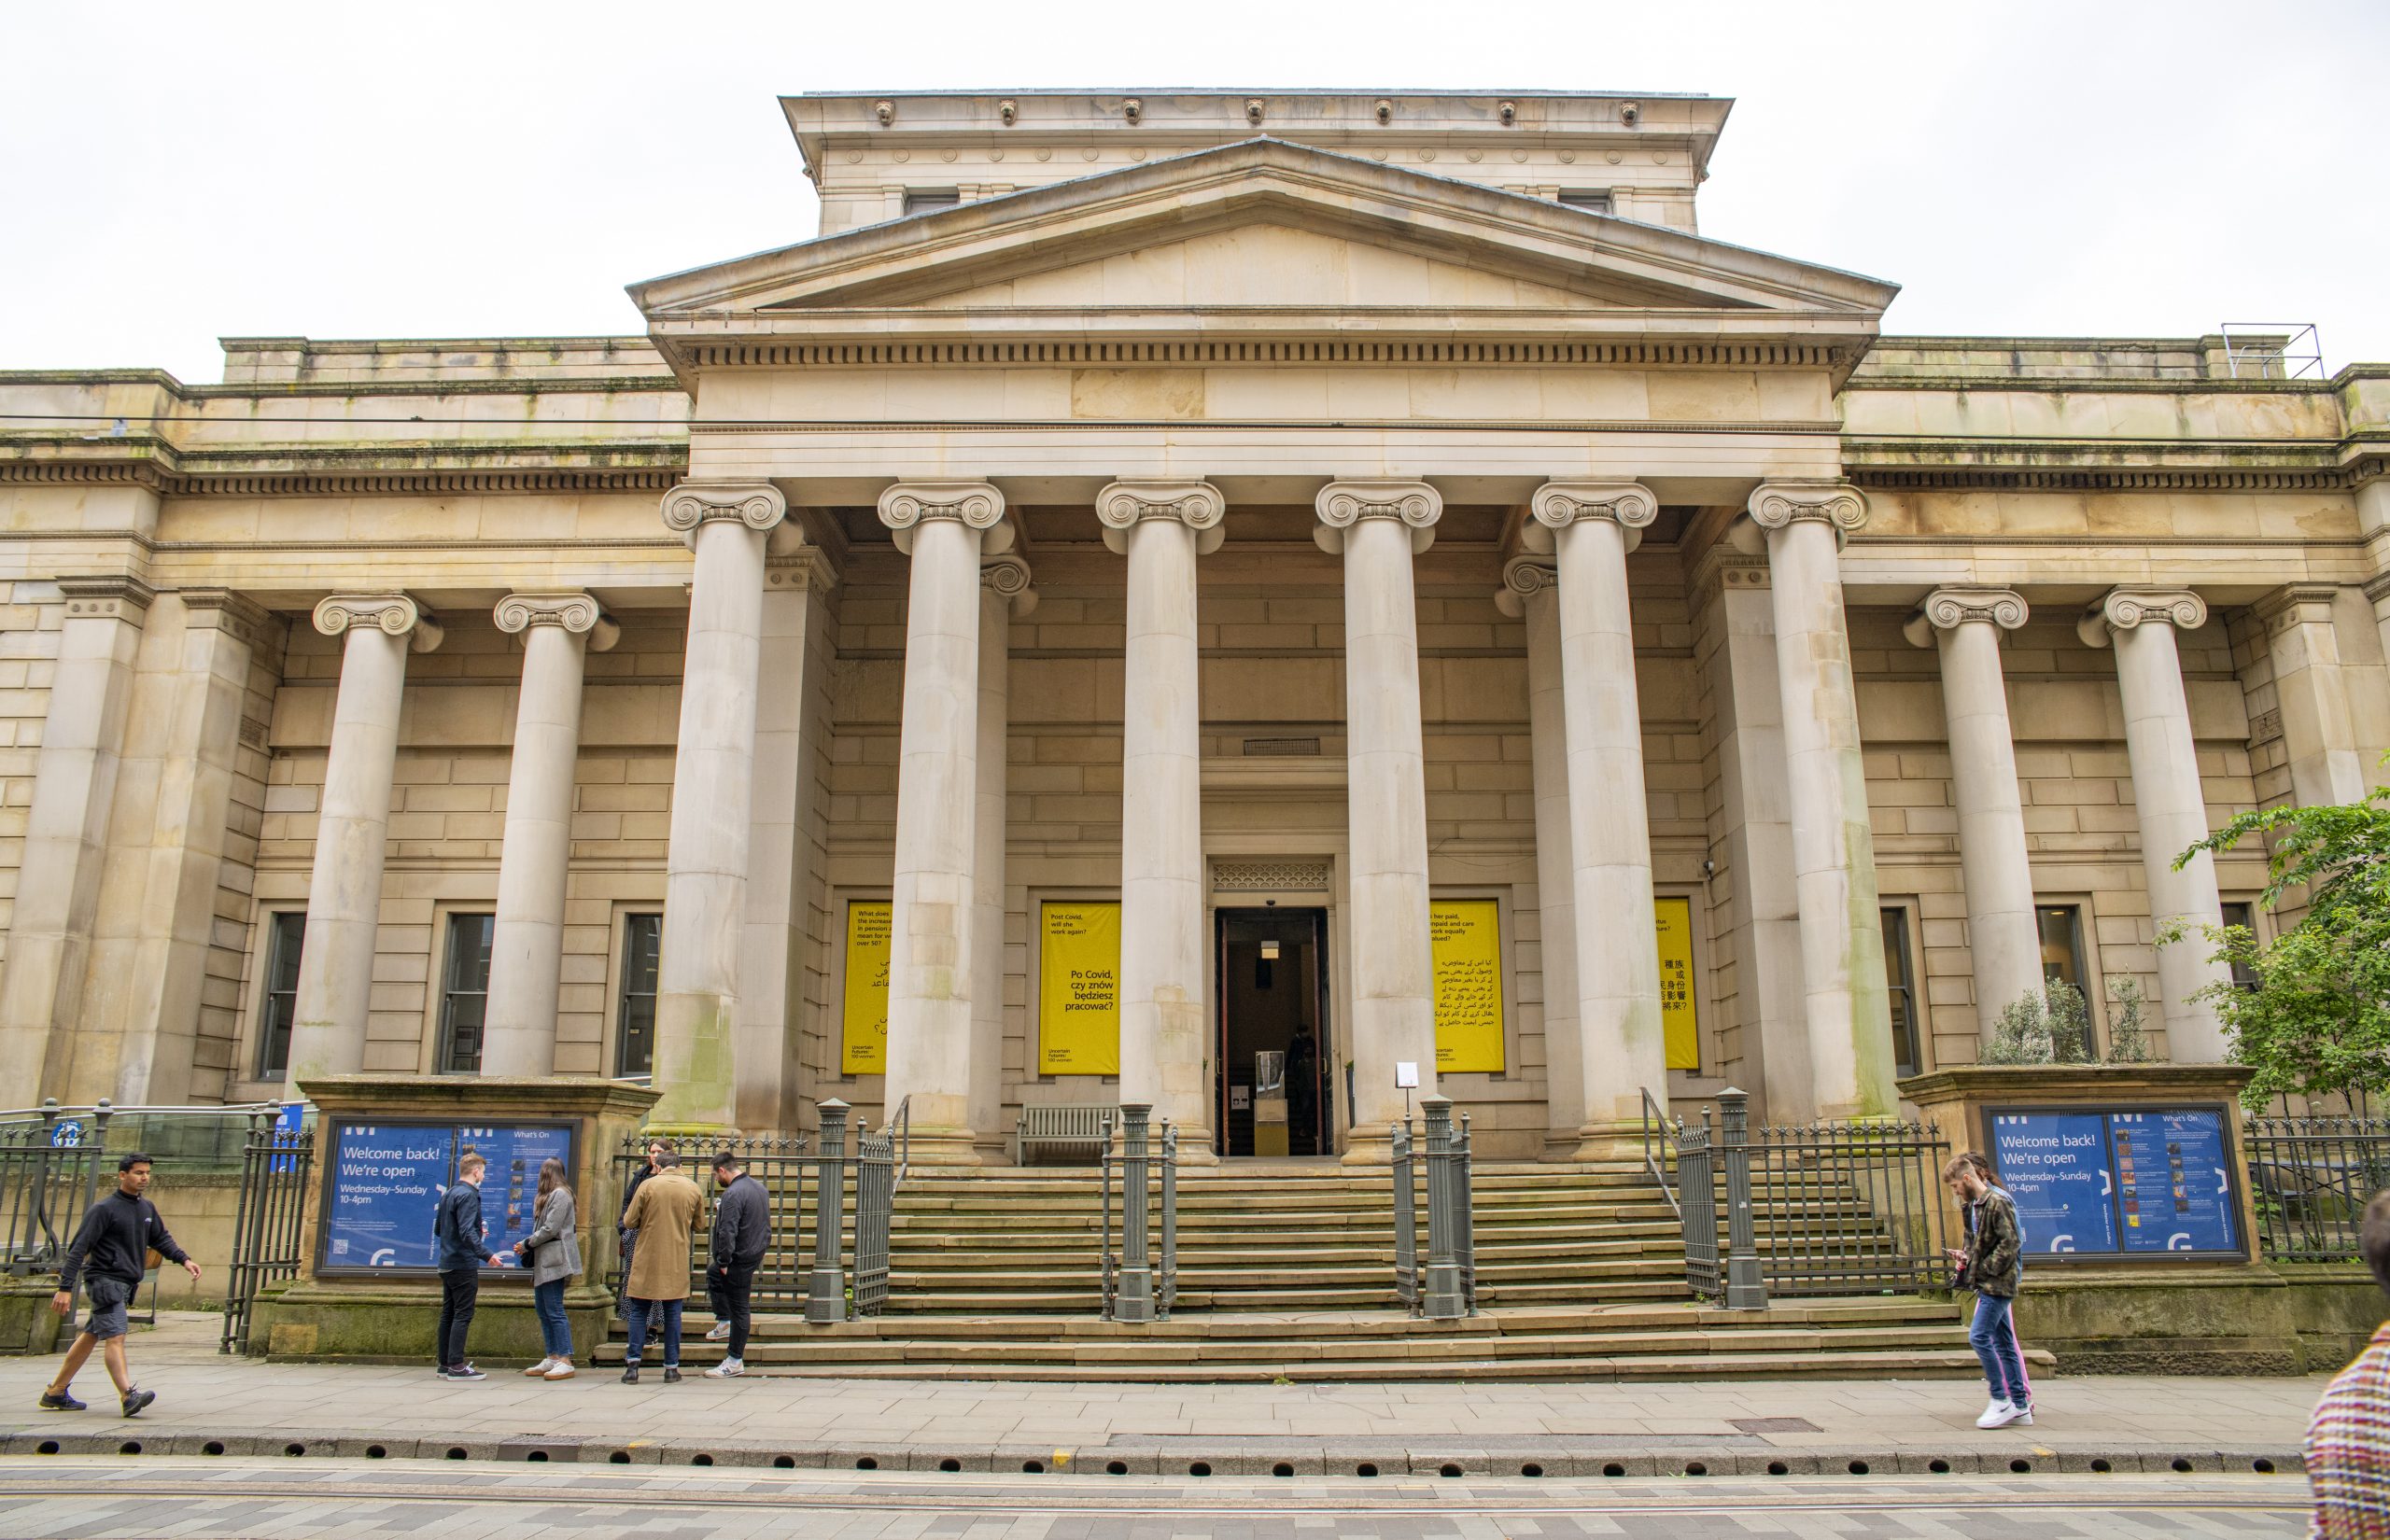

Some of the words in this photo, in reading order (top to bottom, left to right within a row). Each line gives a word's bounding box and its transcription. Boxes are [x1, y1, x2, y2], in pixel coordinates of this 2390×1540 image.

[1086, 970, 1113, 979] Covid,
[1676, 970, 1685, 979] 或
[1089, 981, 1113, 989] znów
[1075, 991, 1113, 1001] będziesz
[1065, 1002, 1113, 1012] pracować?
[2001, 1135, 2059, 1147] Welcome
[2062, 1134, 2096, 1146] back!
[344, 1147, 402, 1159] Welcome
[406, 1147, 440, 1159] back!
[2003, 1153, 2040, 1164] We're
[2044, 1155, 2076, 1166] open
[342, 1164, 378, 1176] We're
[382, 1168, 415, 1179] open
[2005, 1172, 2091, 1183] Wednesday–Sunday
[340, 1184, 428, 1196] Wednesday–Sunday
[2007, 1184, 2039, 1194] 10-4pm
[340, 1195, 372, 1205] 10-4pm
